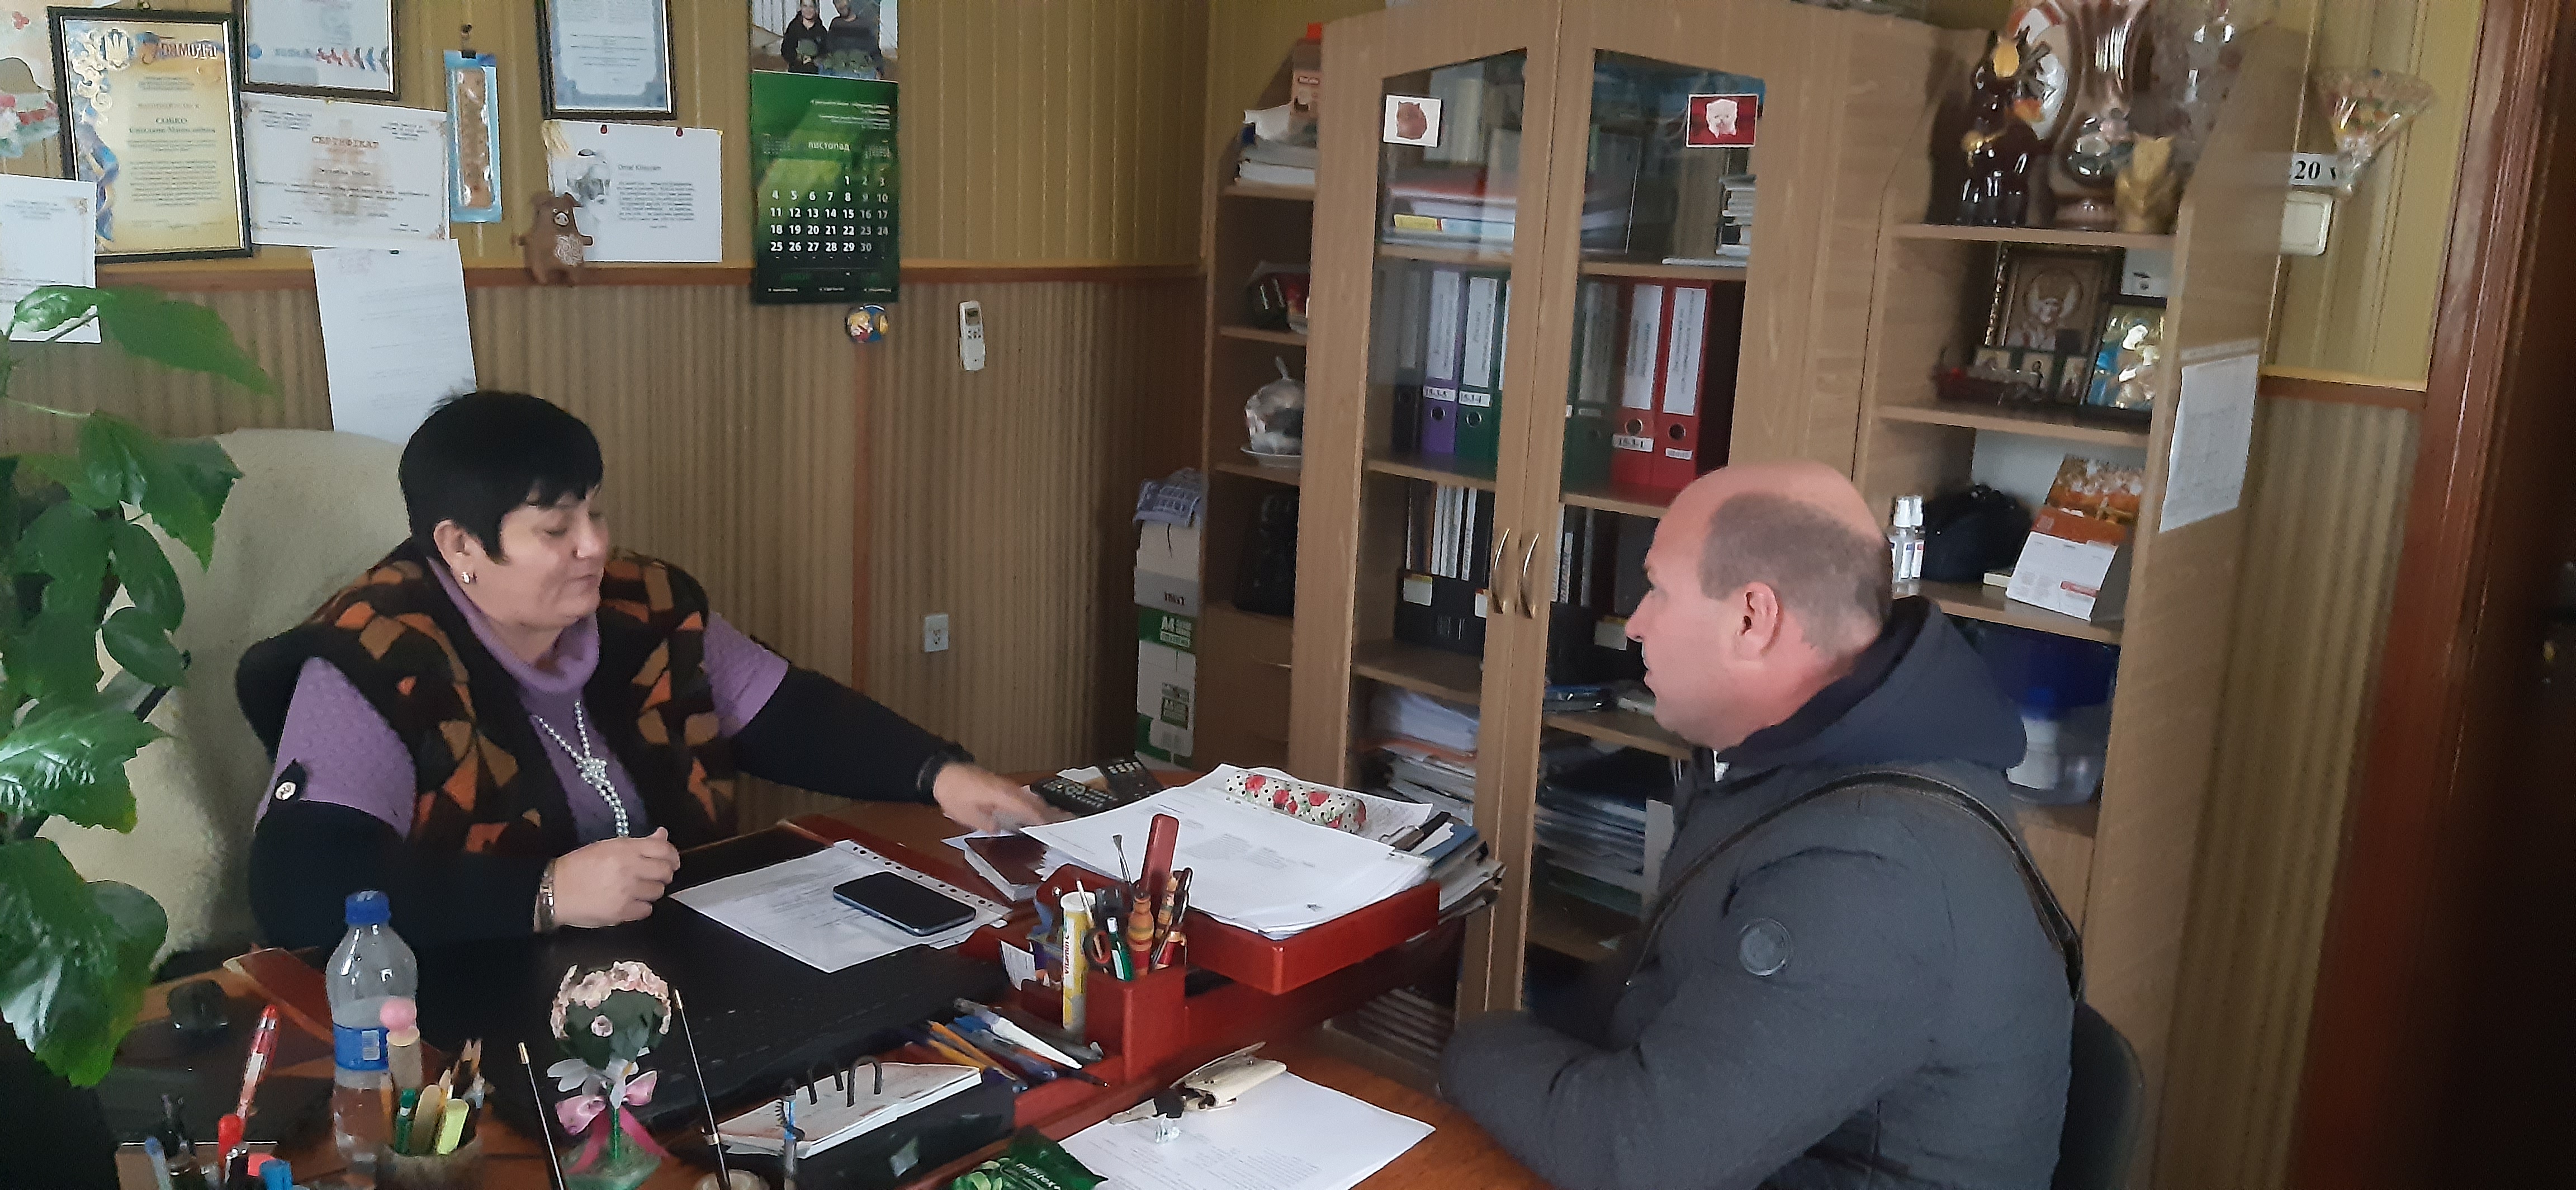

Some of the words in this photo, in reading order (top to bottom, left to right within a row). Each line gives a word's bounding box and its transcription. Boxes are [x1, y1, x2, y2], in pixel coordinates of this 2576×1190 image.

[2294, 160, 2321, 180] 20
[845, 176, 850, 185] 1
[879, 177, 885, 186] 3
[772, 190, 779, 200] 4
[791, 191, 797, 200] 5
[809, 191, 816, 201] 6
[827, 192, 834, 201] 7
[845, 192, 851, 202] 8
[877, 193, 888, 202] 10
[770, 207, 782, 217] 11
[789, 208, 801, 218] 12
[807, 209, 819, 218] 13
[825, 209, 837, 218] 14
[843, 209, 854, 219] 15
[860, 210, 871, 219] 16
[878, 210, 888, 219] 17
[770, 224, 782, 234] 18
[789, 225, 801, 234] 19
[807, 225, 819, 235] 20
[825, 226, 836, 235] 21
[843, 226, 854, 235] 22
[770, 242, 783, 252] 25
[789, 242, 801, 252] 26
[807, 242, 820, 252] 27
[825, 242, 837, 252] 28
[843, 243, 855, 252] 29
[861, 243, 872, 252] 30
